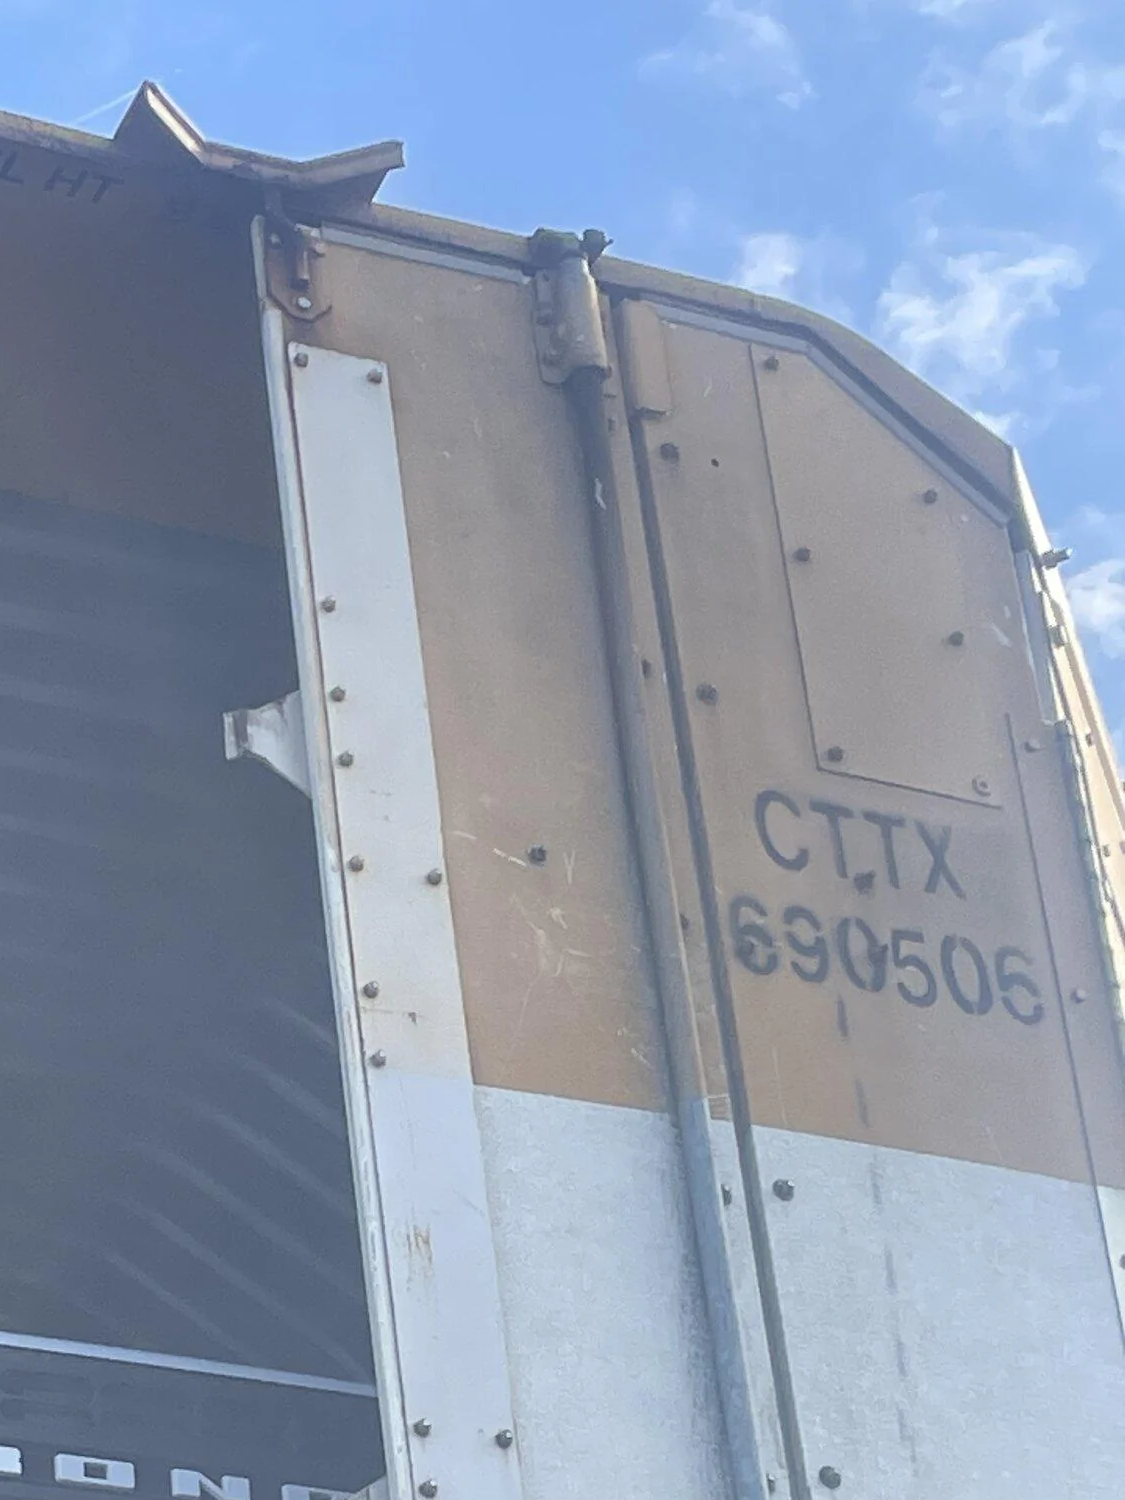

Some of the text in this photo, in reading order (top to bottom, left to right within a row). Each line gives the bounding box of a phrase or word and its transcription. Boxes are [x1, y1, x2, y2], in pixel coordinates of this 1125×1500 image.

[43, 165, 125, 204] HT
[754, 789, 967, 900] CTTX
[728, 893, 1045, 1026] 690506
